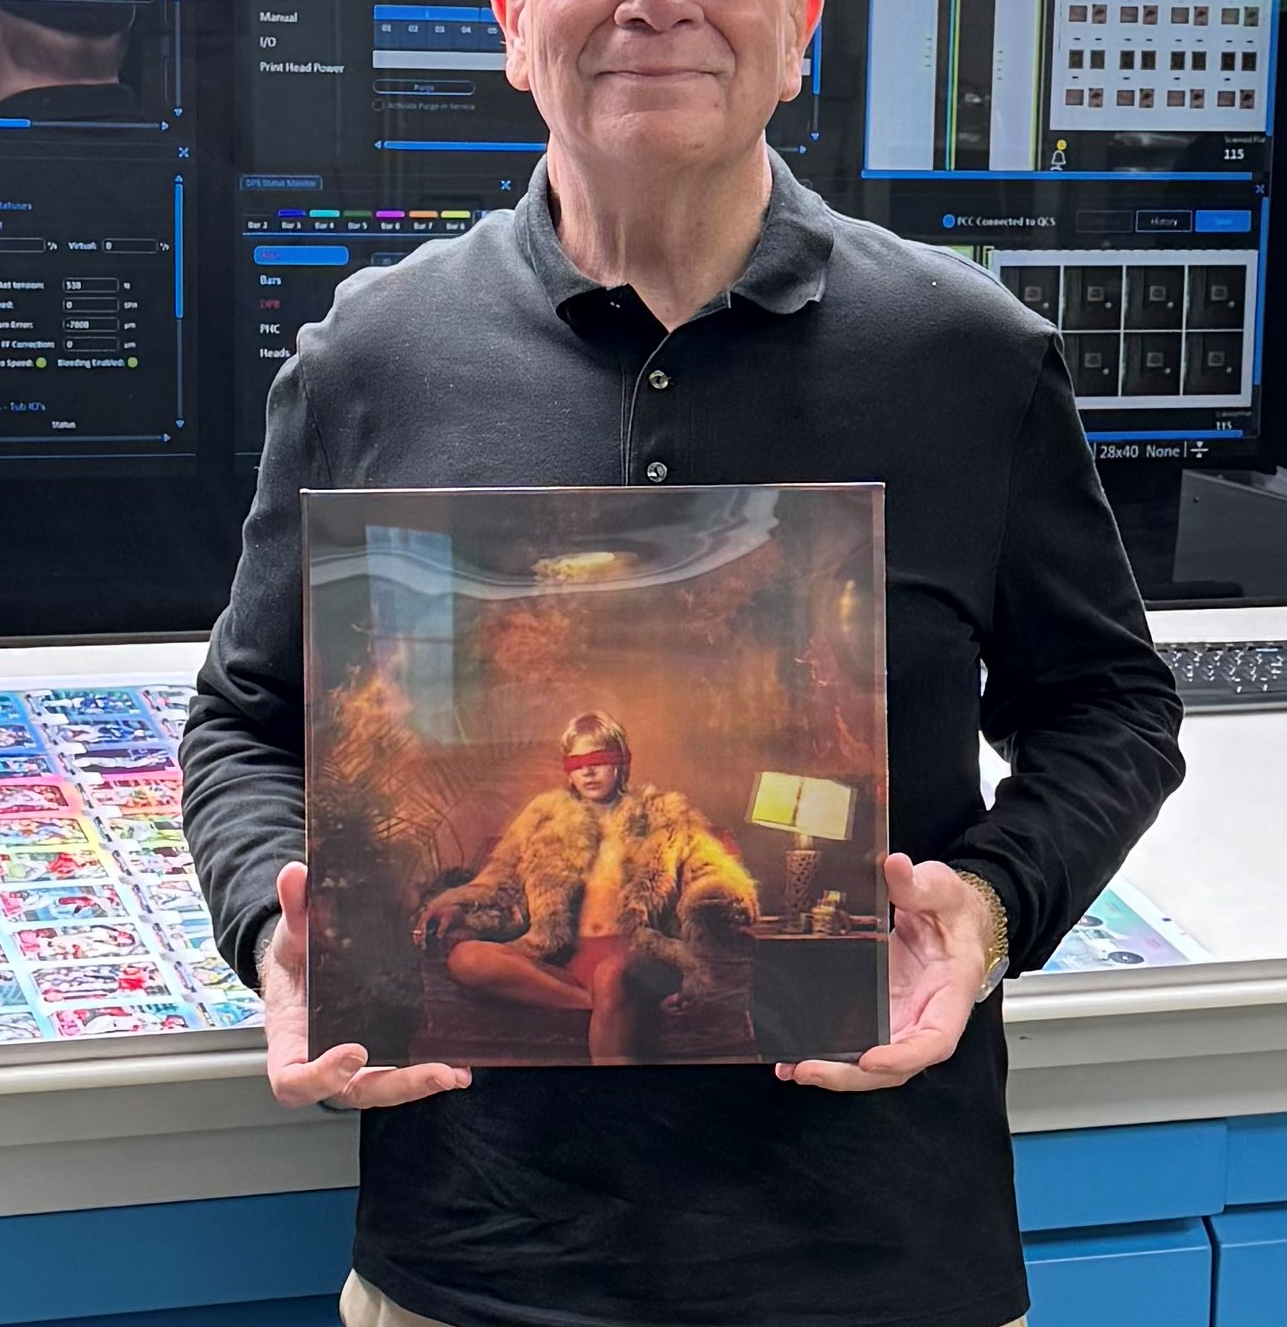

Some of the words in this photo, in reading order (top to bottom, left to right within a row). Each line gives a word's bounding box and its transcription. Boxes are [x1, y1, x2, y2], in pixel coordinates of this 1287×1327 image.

[260, 12, 298, 23] Manual
[260, 36, 277, 48] I/O
[260, 62, 283, 73] Print
[285, 62, 312, 73] Head
[314, 62, 344, 74] Power
[1224, 149, 1244, 160] 115
[976, 216, 1024, 227] Connected
[1026, 217, 1036, 227] to
[1038, 217, 1056, 228] QCS
[1151, 217, 1178, 229] History
[260, 275, 282, 286] Bars
[260, 348, 291, 358] Heads
[10, 402, 26, 411] Tub
[1100, 445, 1139, 459] 28x40
[1146, 445, 1180, 458] None
